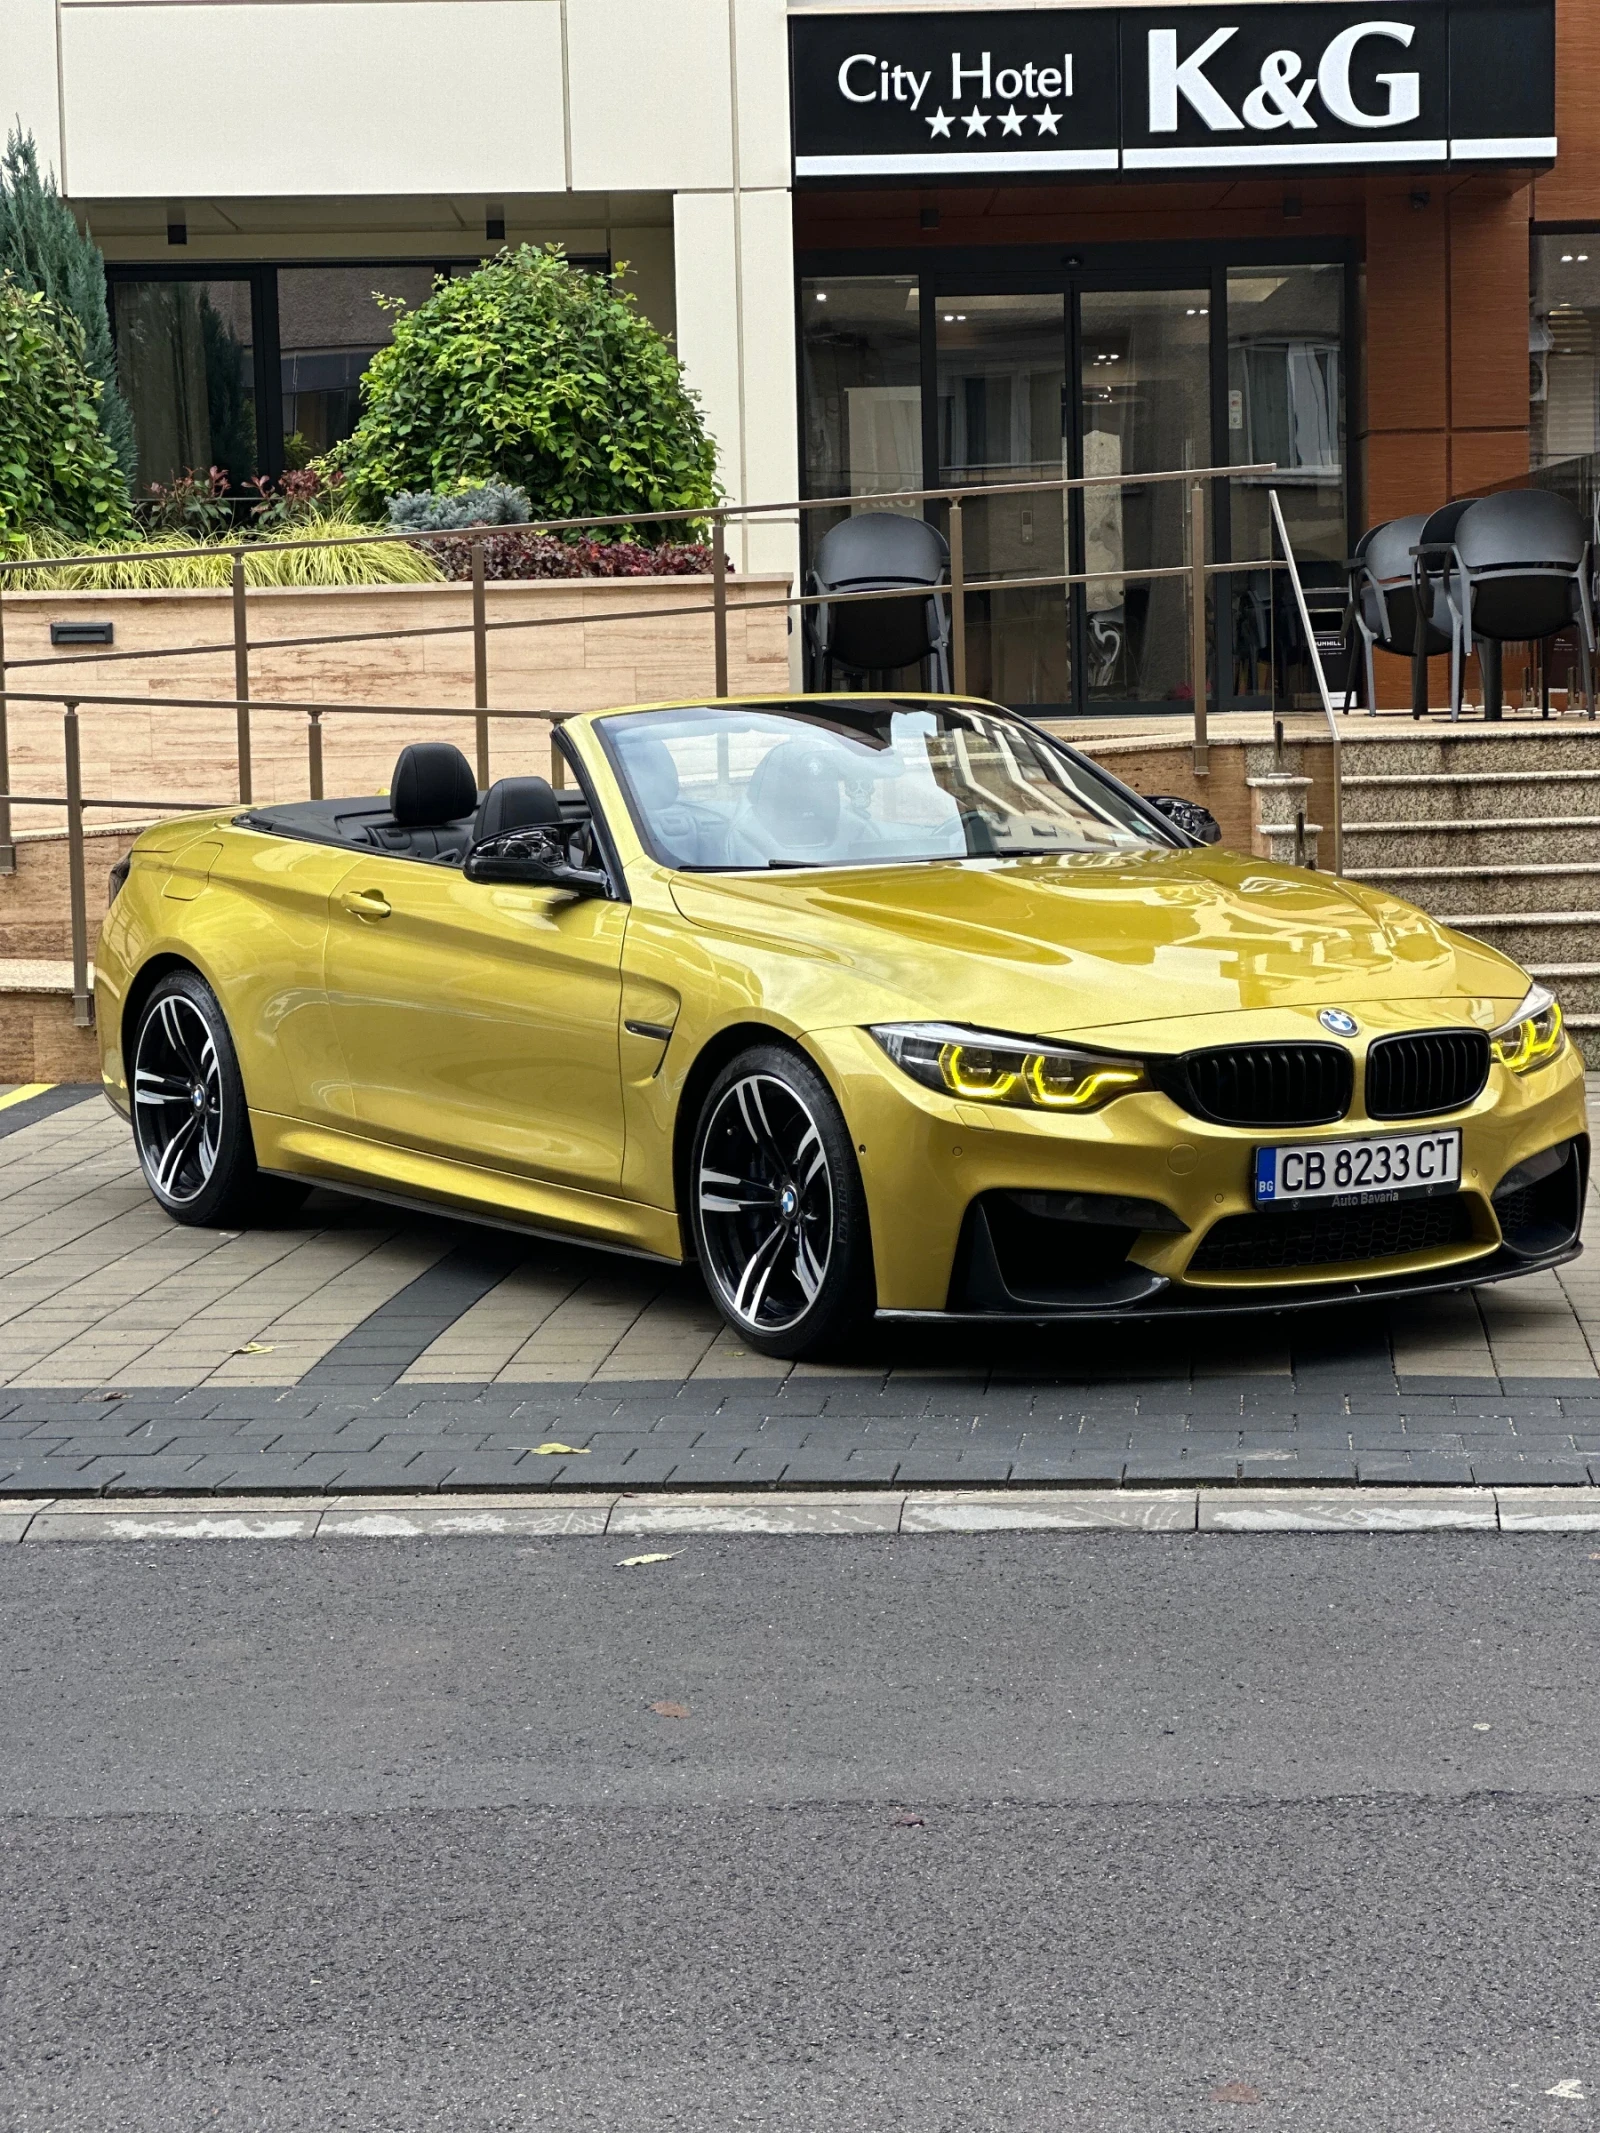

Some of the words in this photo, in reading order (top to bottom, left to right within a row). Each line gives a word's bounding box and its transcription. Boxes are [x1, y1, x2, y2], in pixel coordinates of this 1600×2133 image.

[838, 53, 932, 111] City
[951, 51, 1073, 100] Hotel
[1148, 20, 1420, 132] K&G
[1259, 1181, 1274, 1193] BG
[1282, 1152, 1326, 1191] CB
[1334, 1144, 1410, 1187] 8233
[1416, 1138, 1454, 1178] CT
[1331, 1195, 1359, 1207] Auto
[1360, 1190, 1399, 1205] Bavaria
